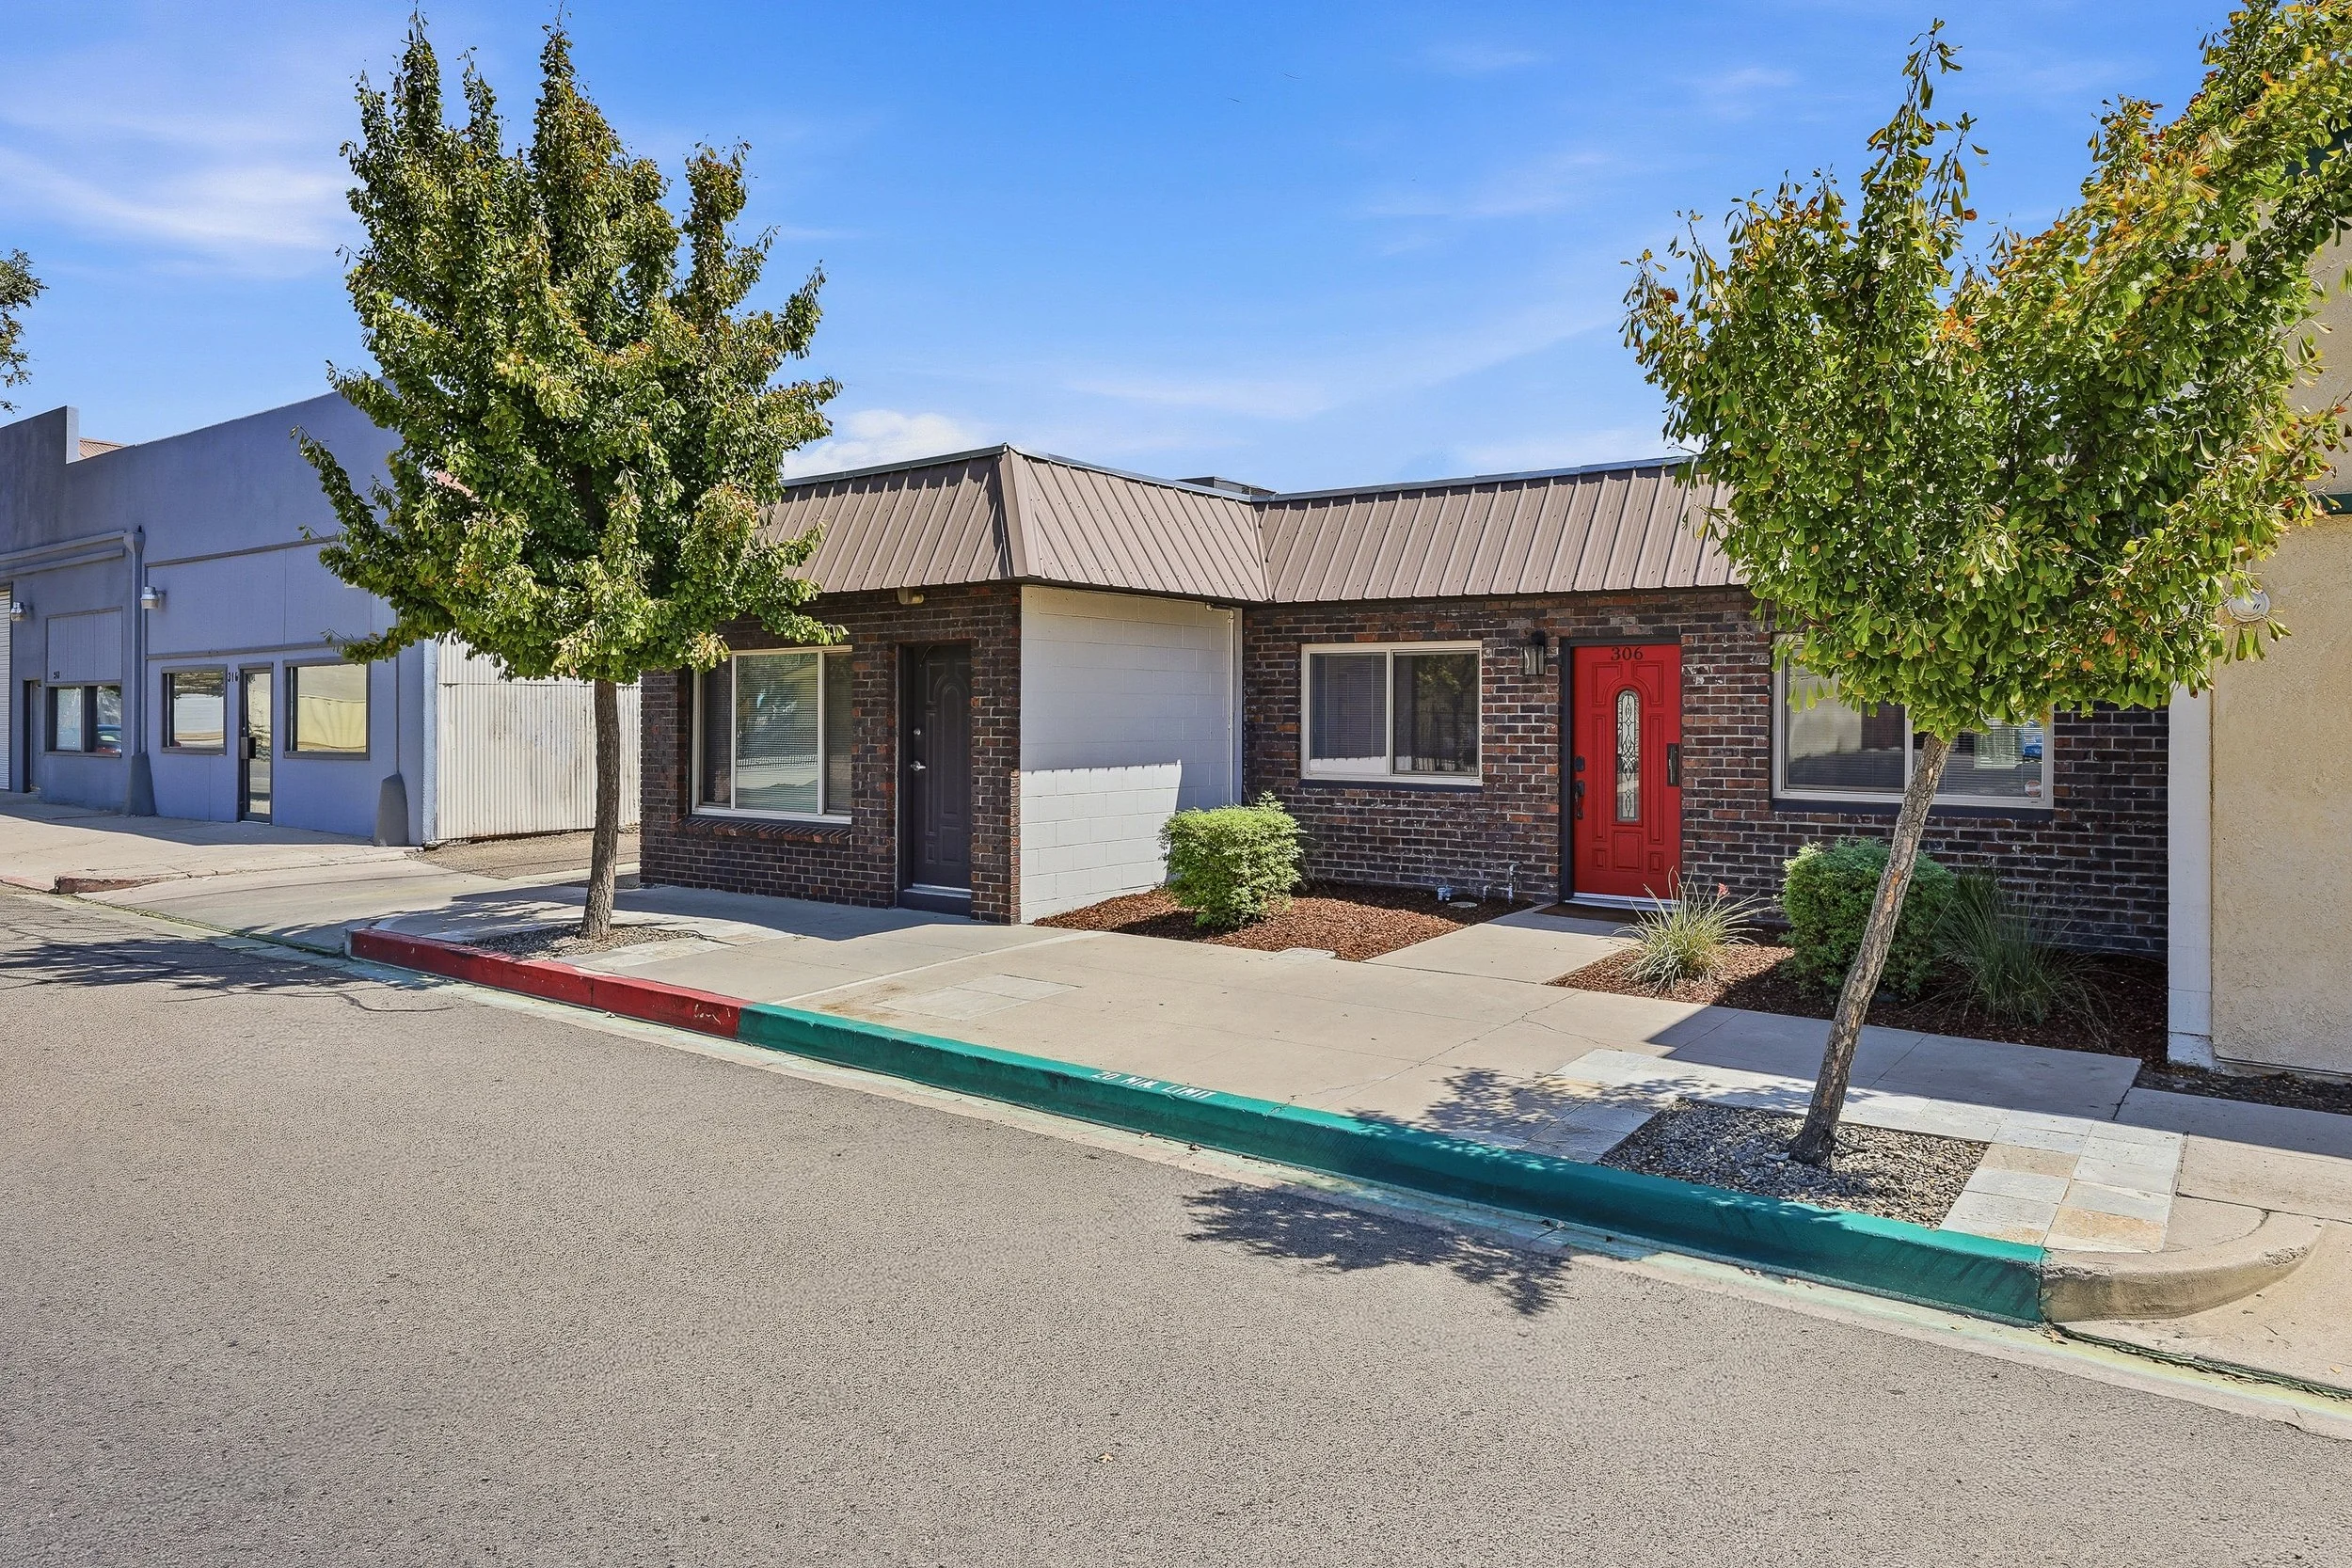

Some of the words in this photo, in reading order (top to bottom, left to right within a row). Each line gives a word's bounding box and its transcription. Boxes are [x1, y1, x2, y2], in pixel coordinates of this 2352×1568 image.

[1611, 646, 1644, 661] 306
[228, 672, 239, 682] 316
[1091, 1070, 1121, 1081] 20
[1161, 1085, 1217, 1100] LIMIT
